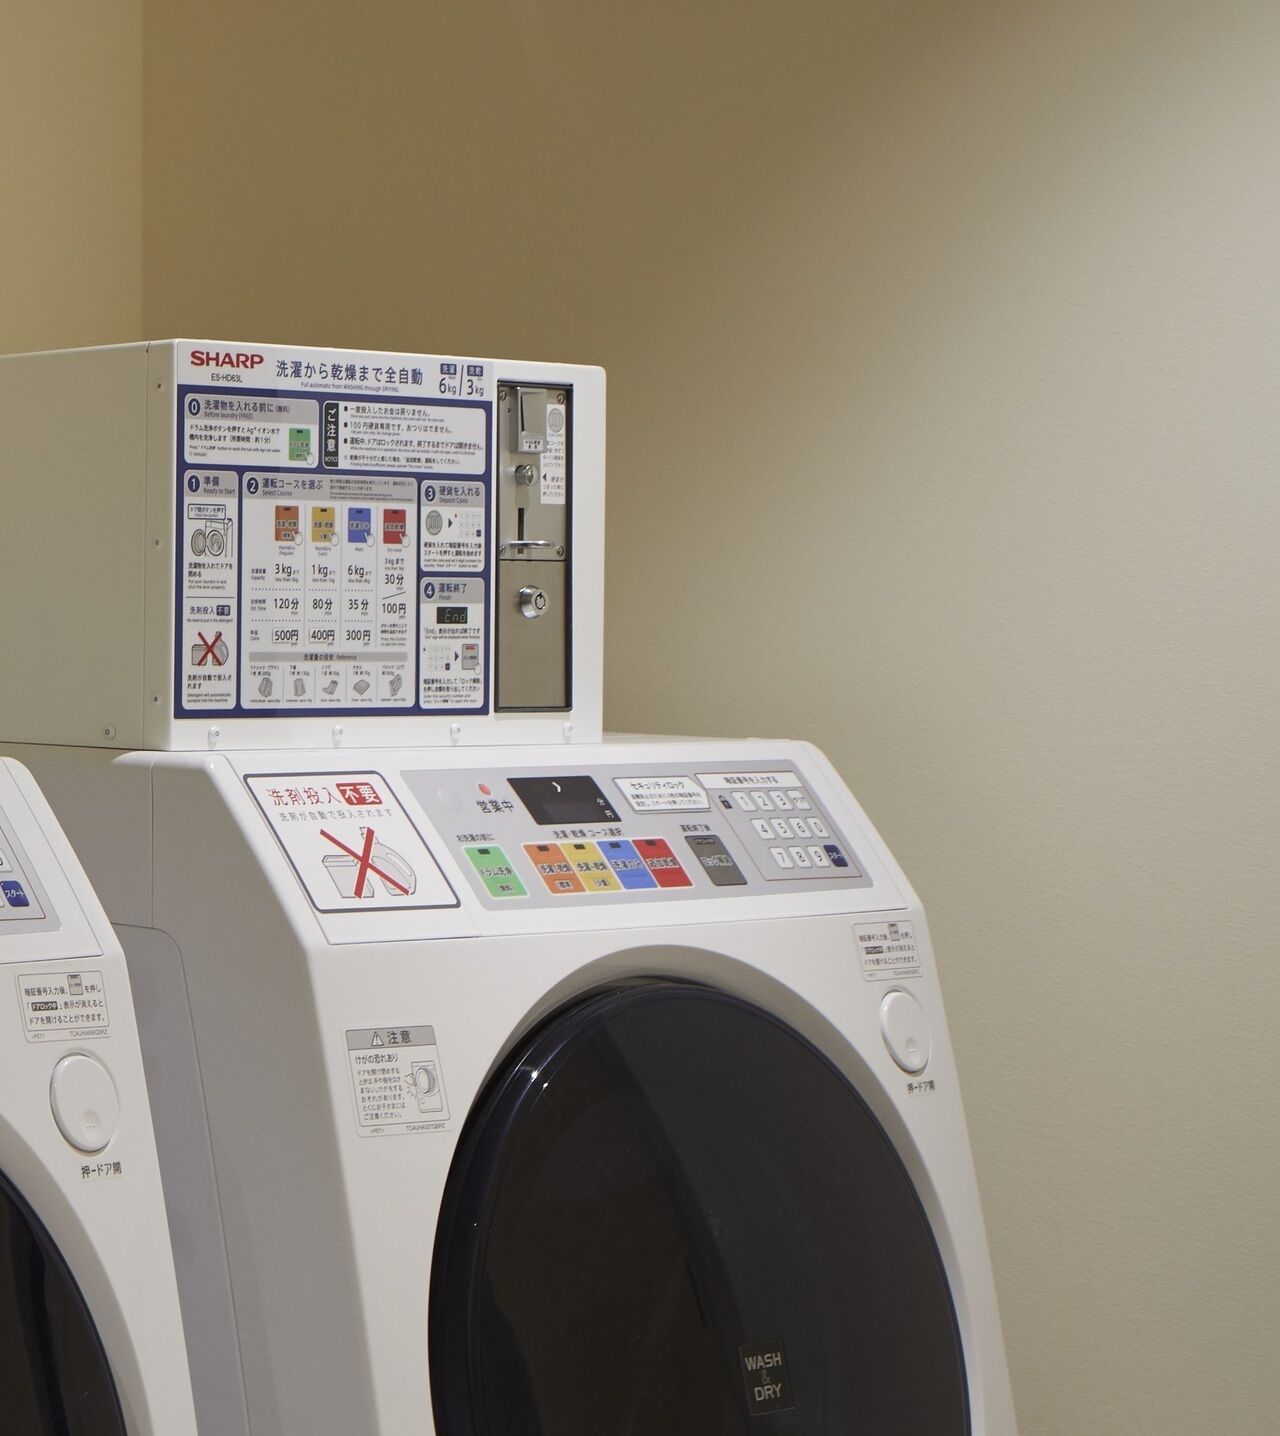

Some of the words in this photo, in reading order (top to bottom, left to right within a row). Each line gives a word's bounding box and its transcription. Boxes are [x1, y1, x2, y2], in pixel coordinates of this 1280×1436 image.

[191, 351, 264, 369] SHARP
[276, 360, 423, 386] 洗濯から乾燥まで全自動
[266, 787, 343, 806] 洗剤投入
[340, 785, 379, 803] 不要
[744, 1352, 782, 1371] WASH
[754, 1383, 781, 1401] DRY
